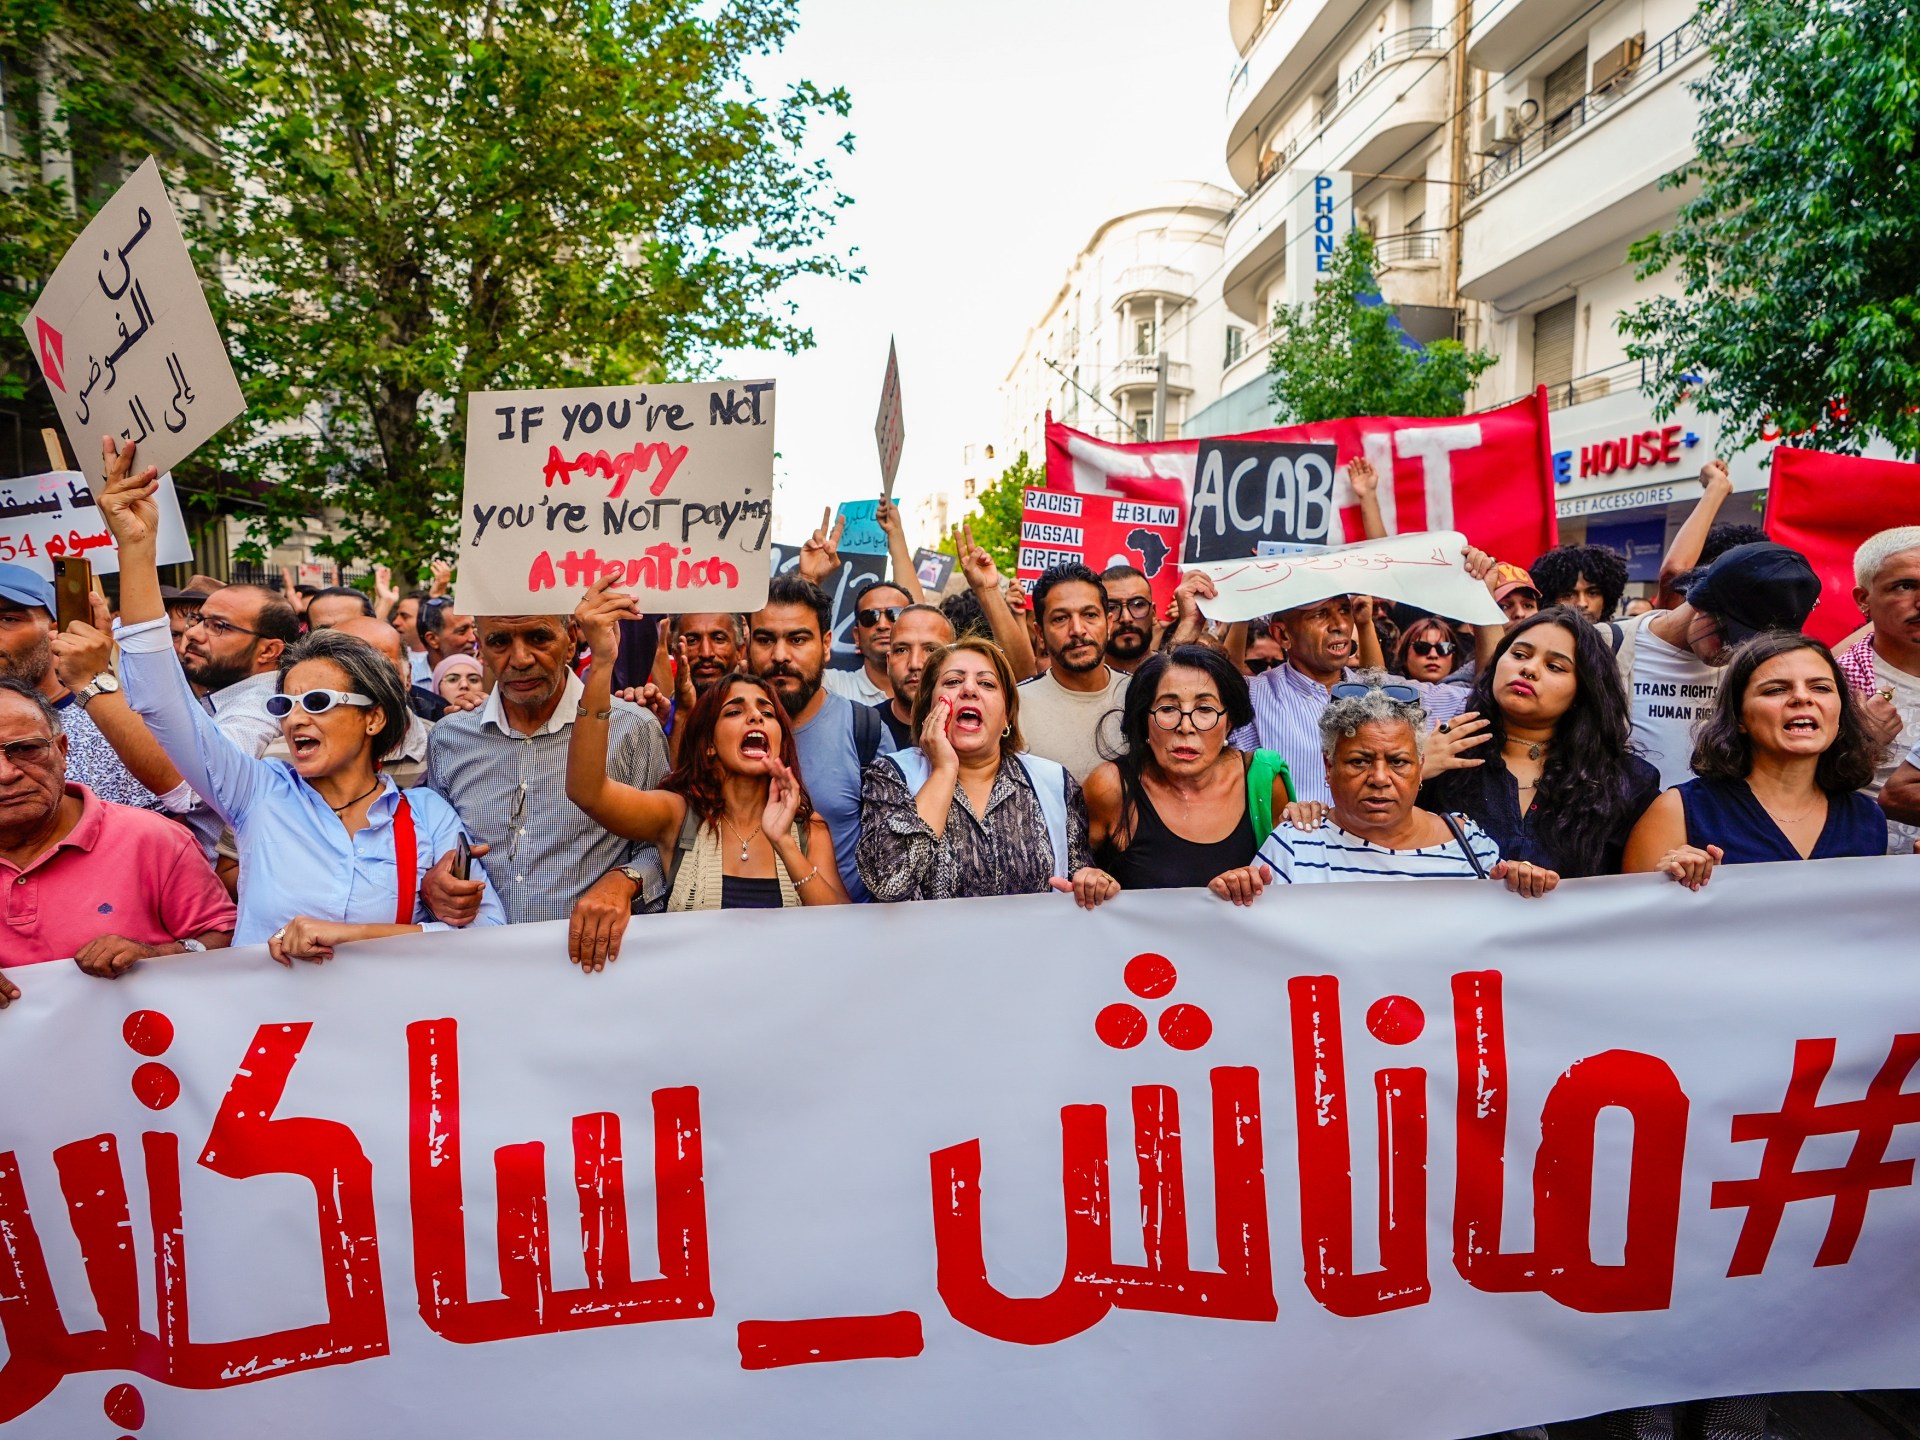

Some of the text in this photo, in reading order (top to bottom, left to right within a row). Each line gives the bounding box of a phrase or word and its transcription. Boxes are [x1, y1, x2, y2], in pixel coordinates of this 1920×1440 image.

[1315, 177, 1334, 272] PHONE
[98, 206, 152, 300] من
[495, 406, 544, 443] IF
[542, 441, 689, 498] Angry
[1025, 491, 1082, 514] RACIST
[1115, 503, 1175, 524] #BLM
[1190, 449, 1333, 541] ACAB
[1575, 501, 1587, 512] ET
[1591, 487, 1673, 511] ACCESSOIRES
[681, 488, 772, 552] paying
[1634, 683, 1676, 697] TRANS
[1648, 705, 1691, 720] HUMAN
